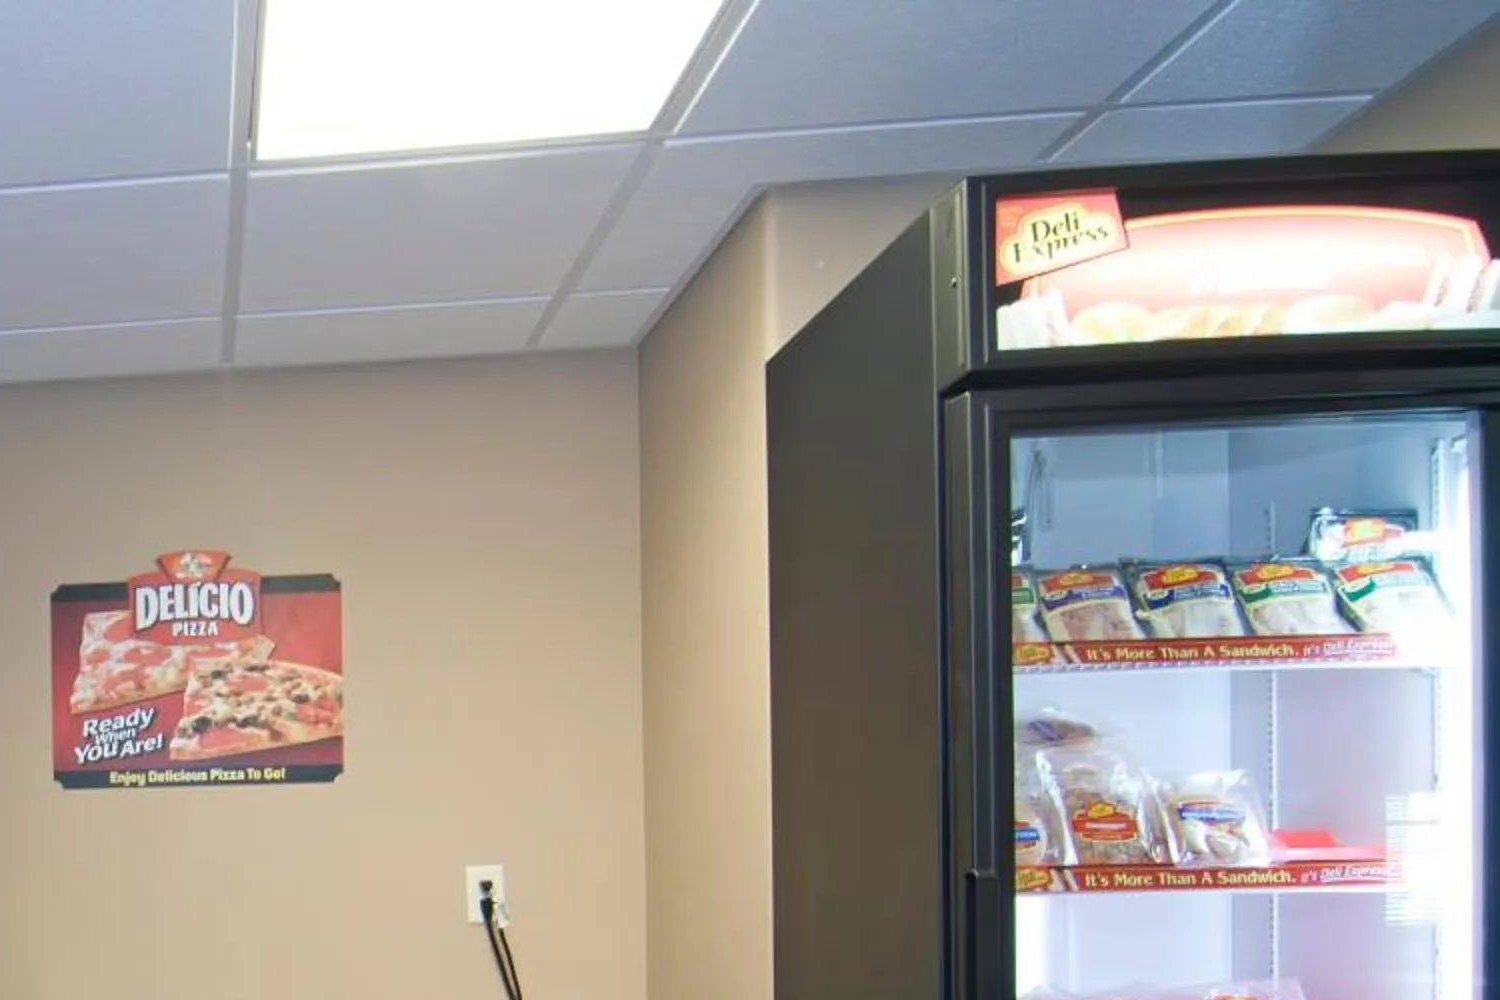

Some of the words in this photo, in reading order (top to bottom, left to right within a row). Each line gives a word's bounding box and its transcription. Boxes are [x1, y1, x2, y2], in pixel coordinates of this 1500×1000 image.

[1031, 211, 1079, 242] Deli
[1014, 227, 1108, 262] Express
[172, 622, 218, 637] PIZZA
[1087, 648, 1111, 661] It's
[1117, 647, 1153, 660] More
[1161, 646, 1199, 659] Than
[1203, 645, 1214, 657] A
[83, 707, 155, 738] Ready
[95, 727, 136, 745] When
[120, 734, 163, 758] Are!
[110, 770, 146, 786] Enjoy
[149, 769, 207, 783] Delicious
[210, 768, 245, 781] Pizza
[248, 768, 262, 780] To
[264, 767, 285, 780] Go!
[1086, 873, 1109, 887] It's
[1114, 873, 1152, 886] More
[1159, 872, 1197, 885] Than
[1202, 872, 1213, 884] A
